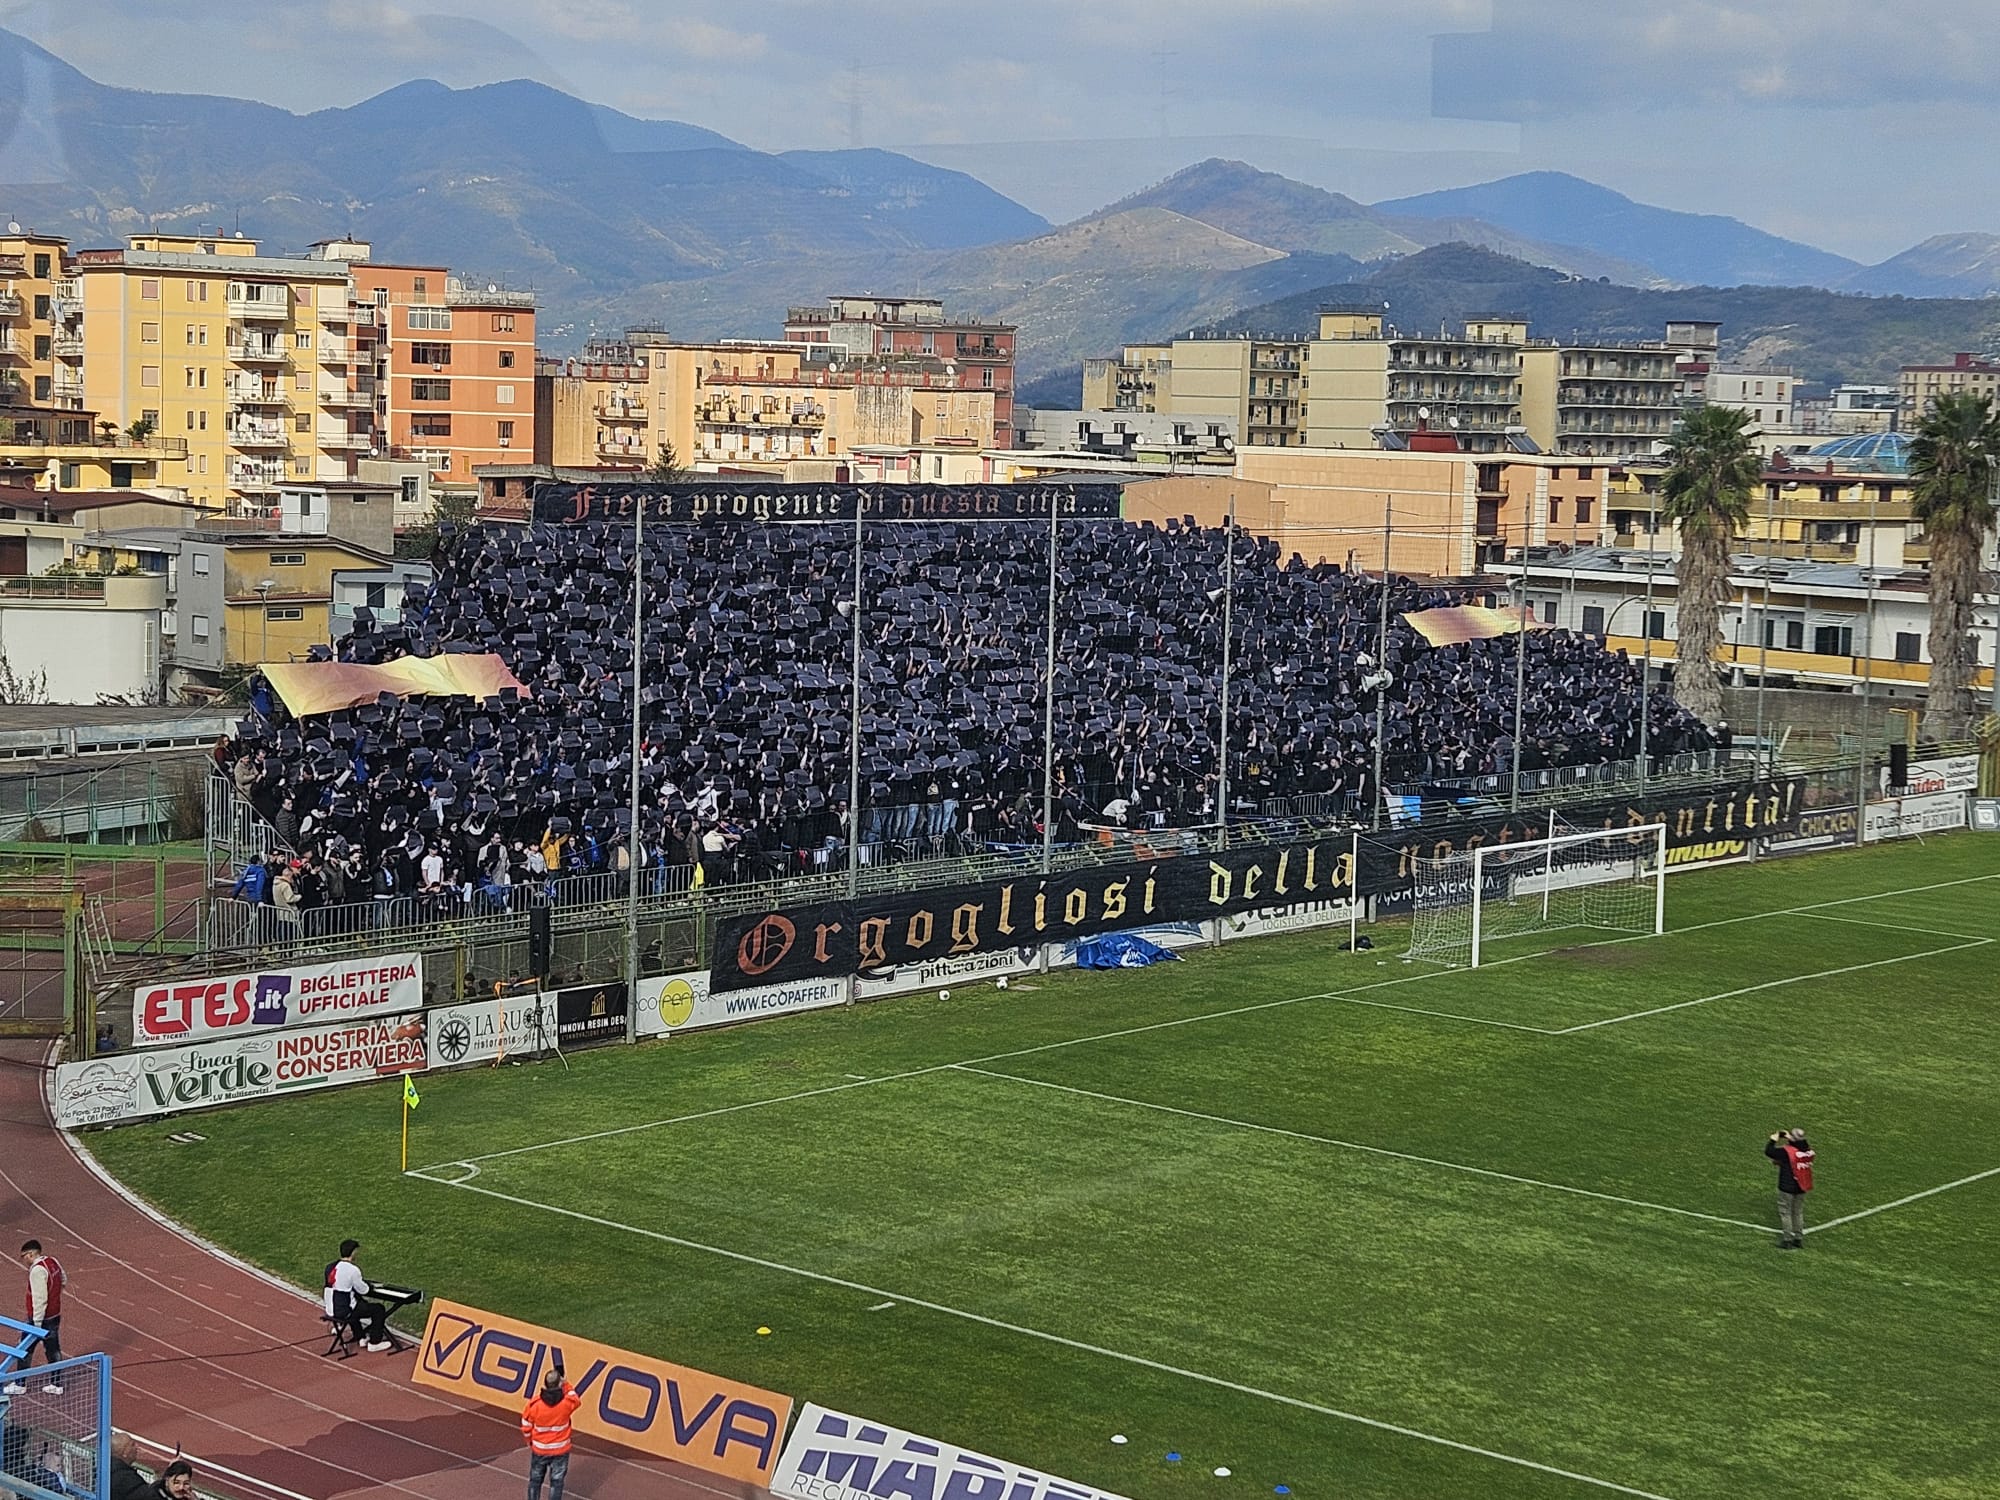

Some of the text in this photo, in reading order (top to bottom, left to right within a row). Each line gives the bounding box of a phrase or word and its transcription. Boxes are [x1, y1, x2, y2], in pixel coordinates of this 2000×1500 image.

[562, 485, 674, 523] Fiera
[691, 487, 842, 521] progenie
[900, 488, 999, 518] questa
[1799, 811, 1857, 838] CHICKEN
[1654, 838, 1745, 866] INALDO
[737, 865, 1158, 976] Orgogliosi
[1208, 845, 1354, 905] della
[1262, 913, 1305, 931] LOGISTICS
[300, 963, 416, 995] BIGLIETTERIA
[144, 979, 281, 1035] ETES .it
[299, 988, 390, 1014] UFFICIALE
[475, 1014, 494, 1036] LA
[499, 1004, 556, 1034] RUOA
[560, 1020, 585, 1034] INNOVA
[587, 1016, 609, 1030] RESIN
[276, 1025, 390, 1060] INDUSTRIA
[181, 1050, 234, 1074] Linea
[275, 1039, 426, 1080] CONSERVIERA
[145, 1056, 273, 1108] Verde
[470, 1329, 778, 1471] GIVOVA
